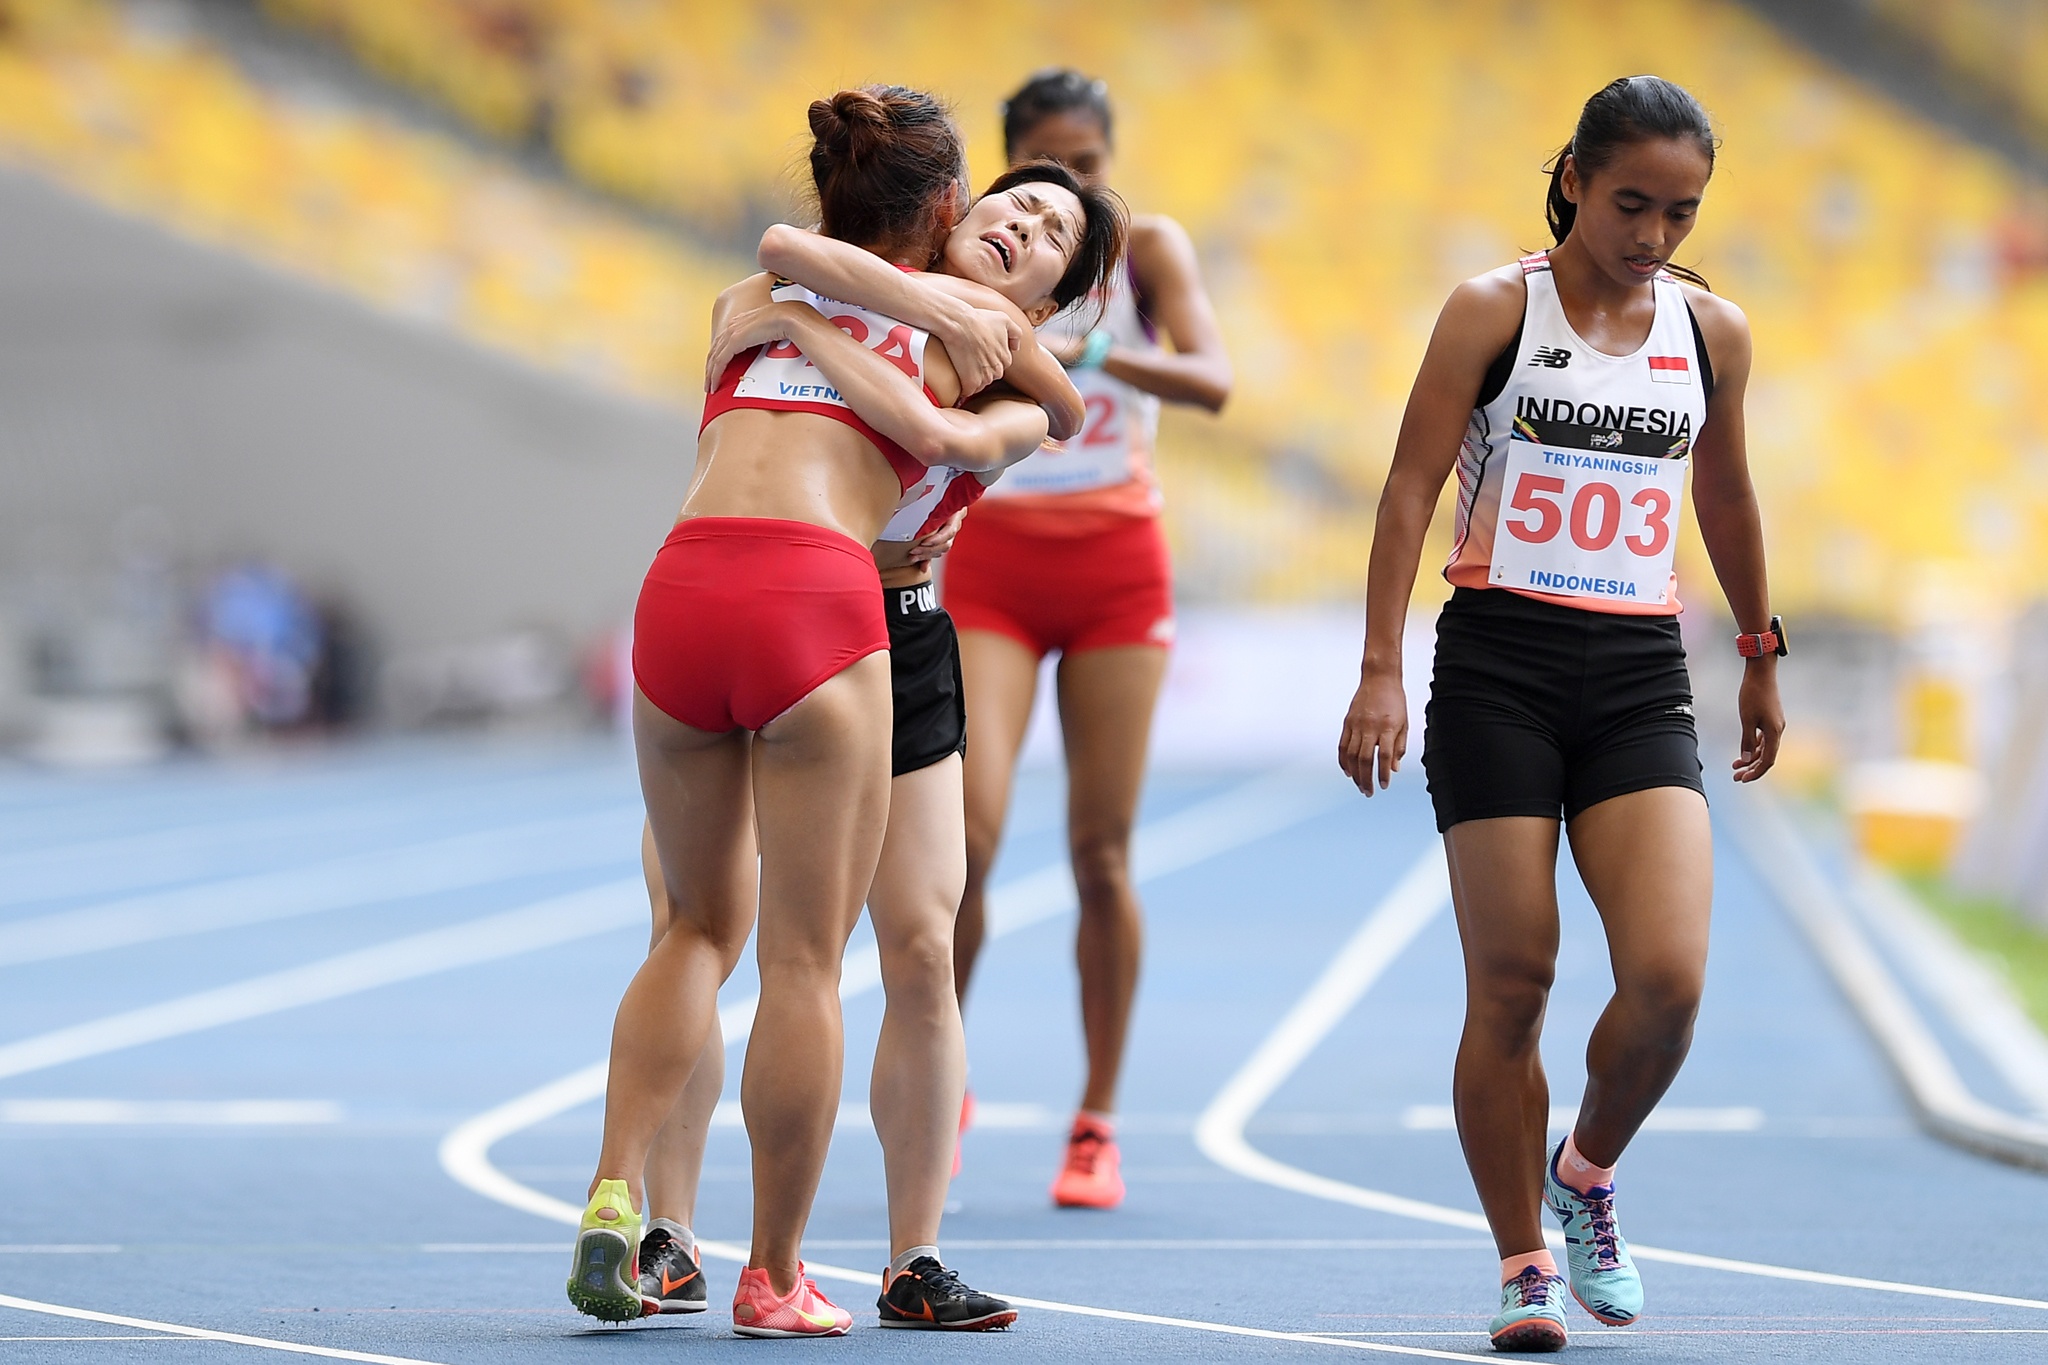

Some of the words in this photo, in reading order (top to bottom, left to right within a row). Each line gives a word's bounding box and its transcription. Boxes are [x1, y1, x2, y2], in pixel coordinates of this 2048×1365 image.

[779, 382, 844, 402] VIETN
[1516, 396, 1690, 437] INDONESIA
[1543, 451, 1658, 476] TRIYANINGSIH
[1505, 472, 1671, 557] 503
[1529, 570, 1636, 597] INDONESIA
